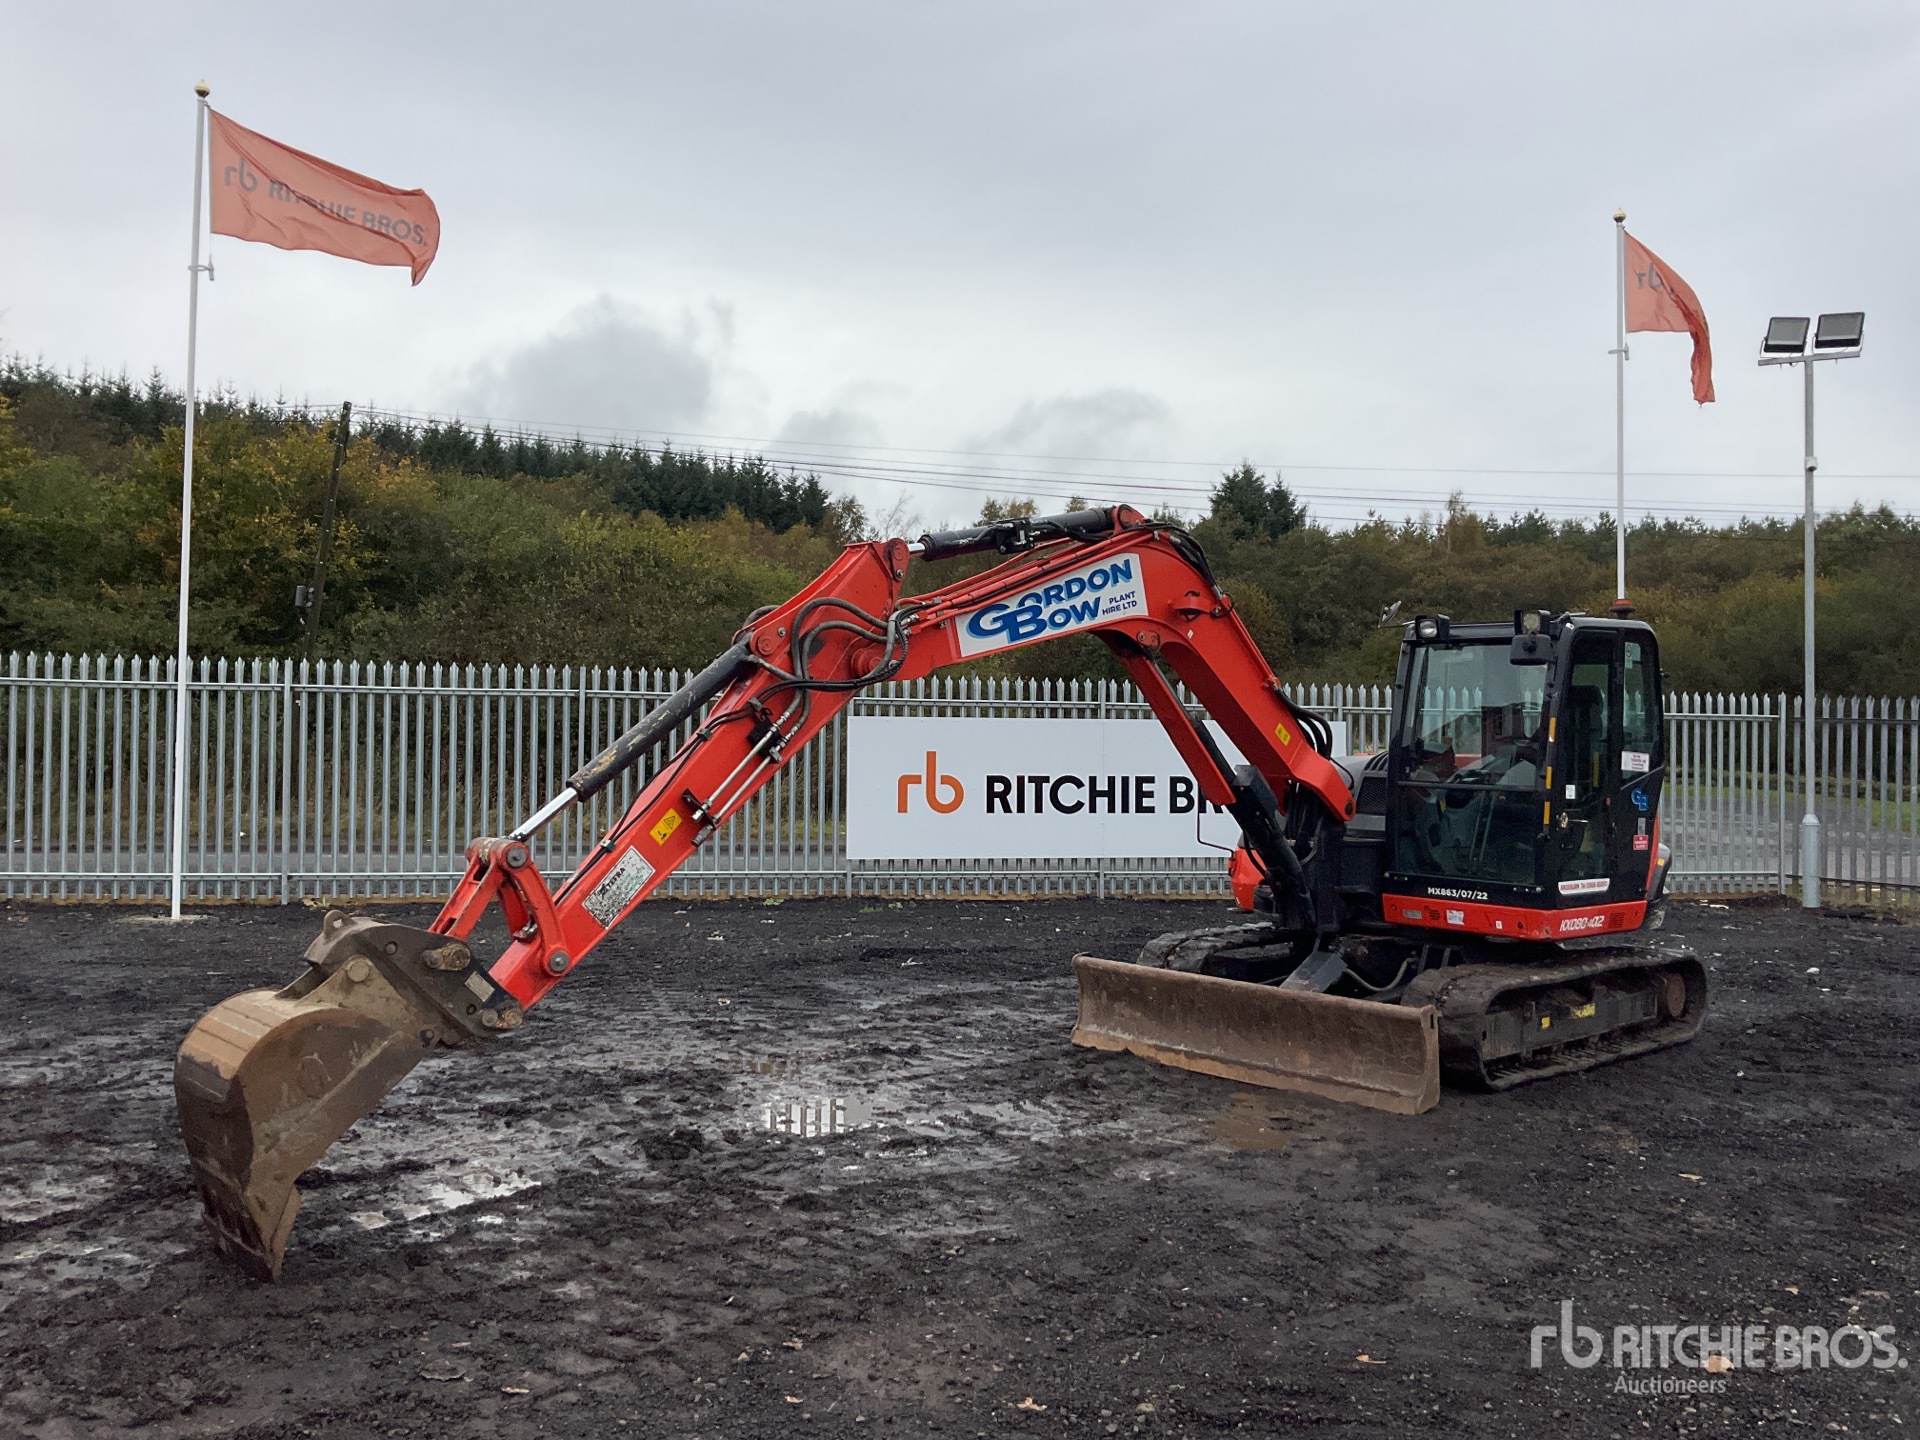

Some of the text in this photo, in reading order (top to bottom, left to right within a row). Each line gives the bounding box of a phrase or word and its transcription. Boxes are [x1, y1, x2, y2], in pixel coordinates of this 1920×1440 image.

[966, 558, 1133, 639] GORDON
[1101, 600, 1138, 616] HIRE LTD
[1108, 591, 1136, 605] PLANT
[1005, 596, 1102, 644] BOW
[897, 750, 965, 814] rb
[986, 775, 1156, 814] RITCHIE
[1427, 886, 1489, 900] MX863/07/22
